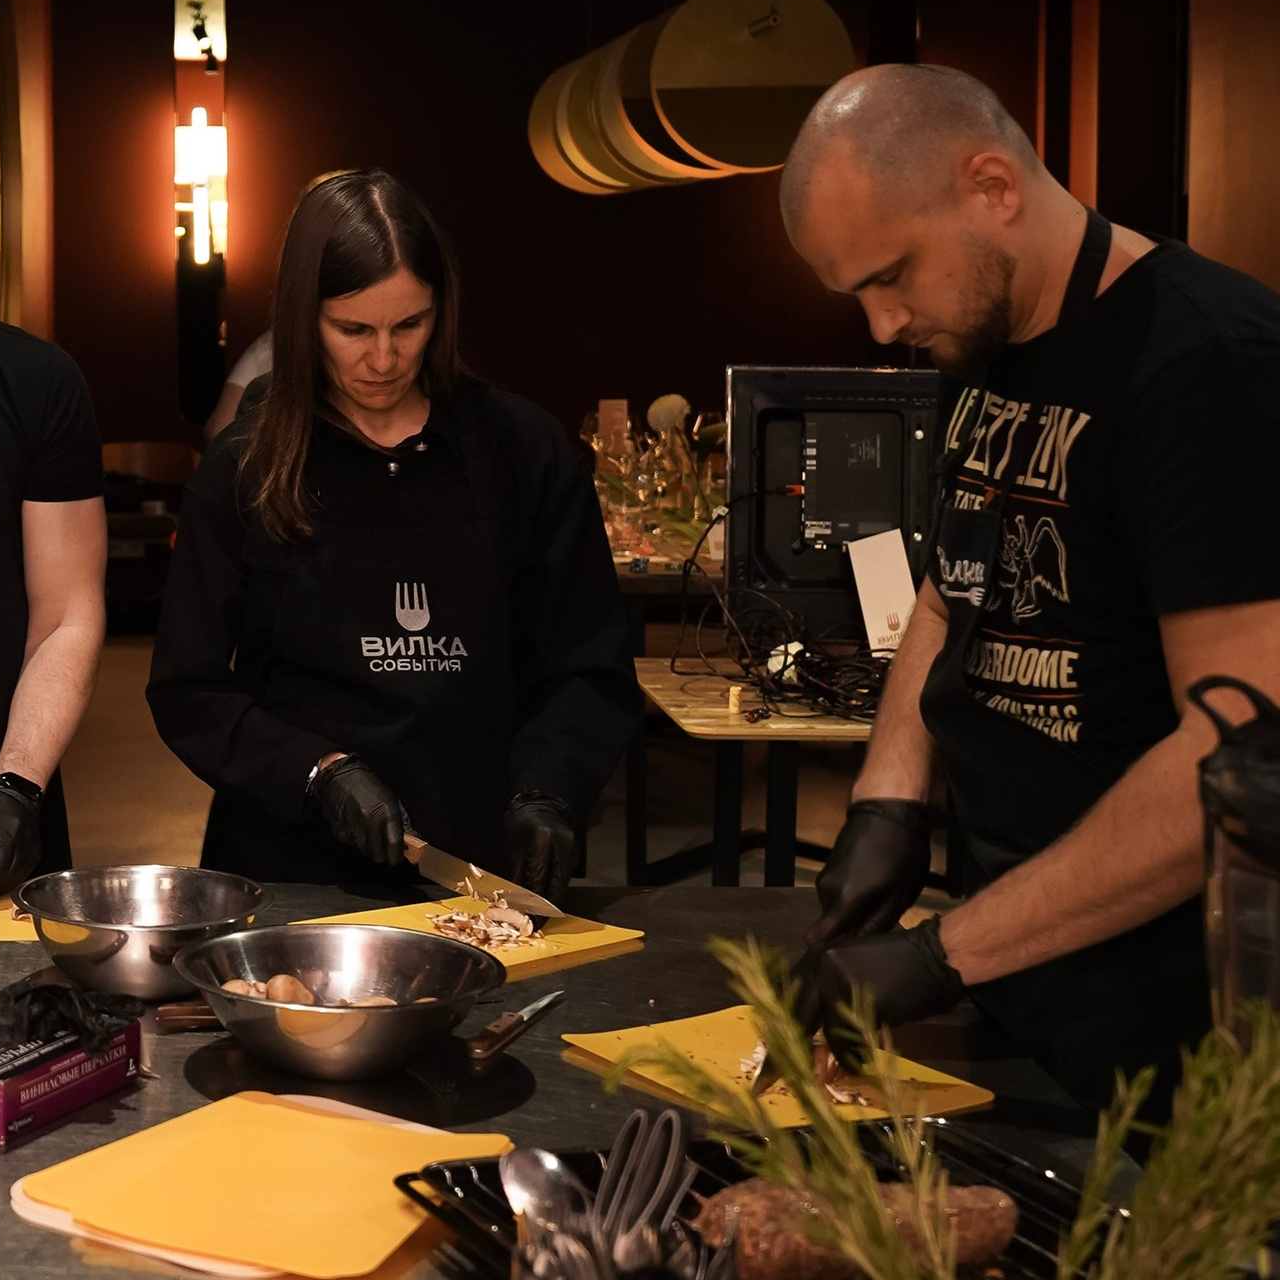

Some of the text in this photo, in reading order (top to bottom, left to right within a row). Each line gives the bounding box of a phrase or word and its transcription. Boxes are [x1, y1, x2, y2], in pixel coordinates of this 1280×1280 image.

[360, 635, 469, 657] ВИЛКА
[370, 658, 462, 672] СОБЫТИЯ
[20, 1066, 80, 1104] ВИНИЛОВЫЕ
